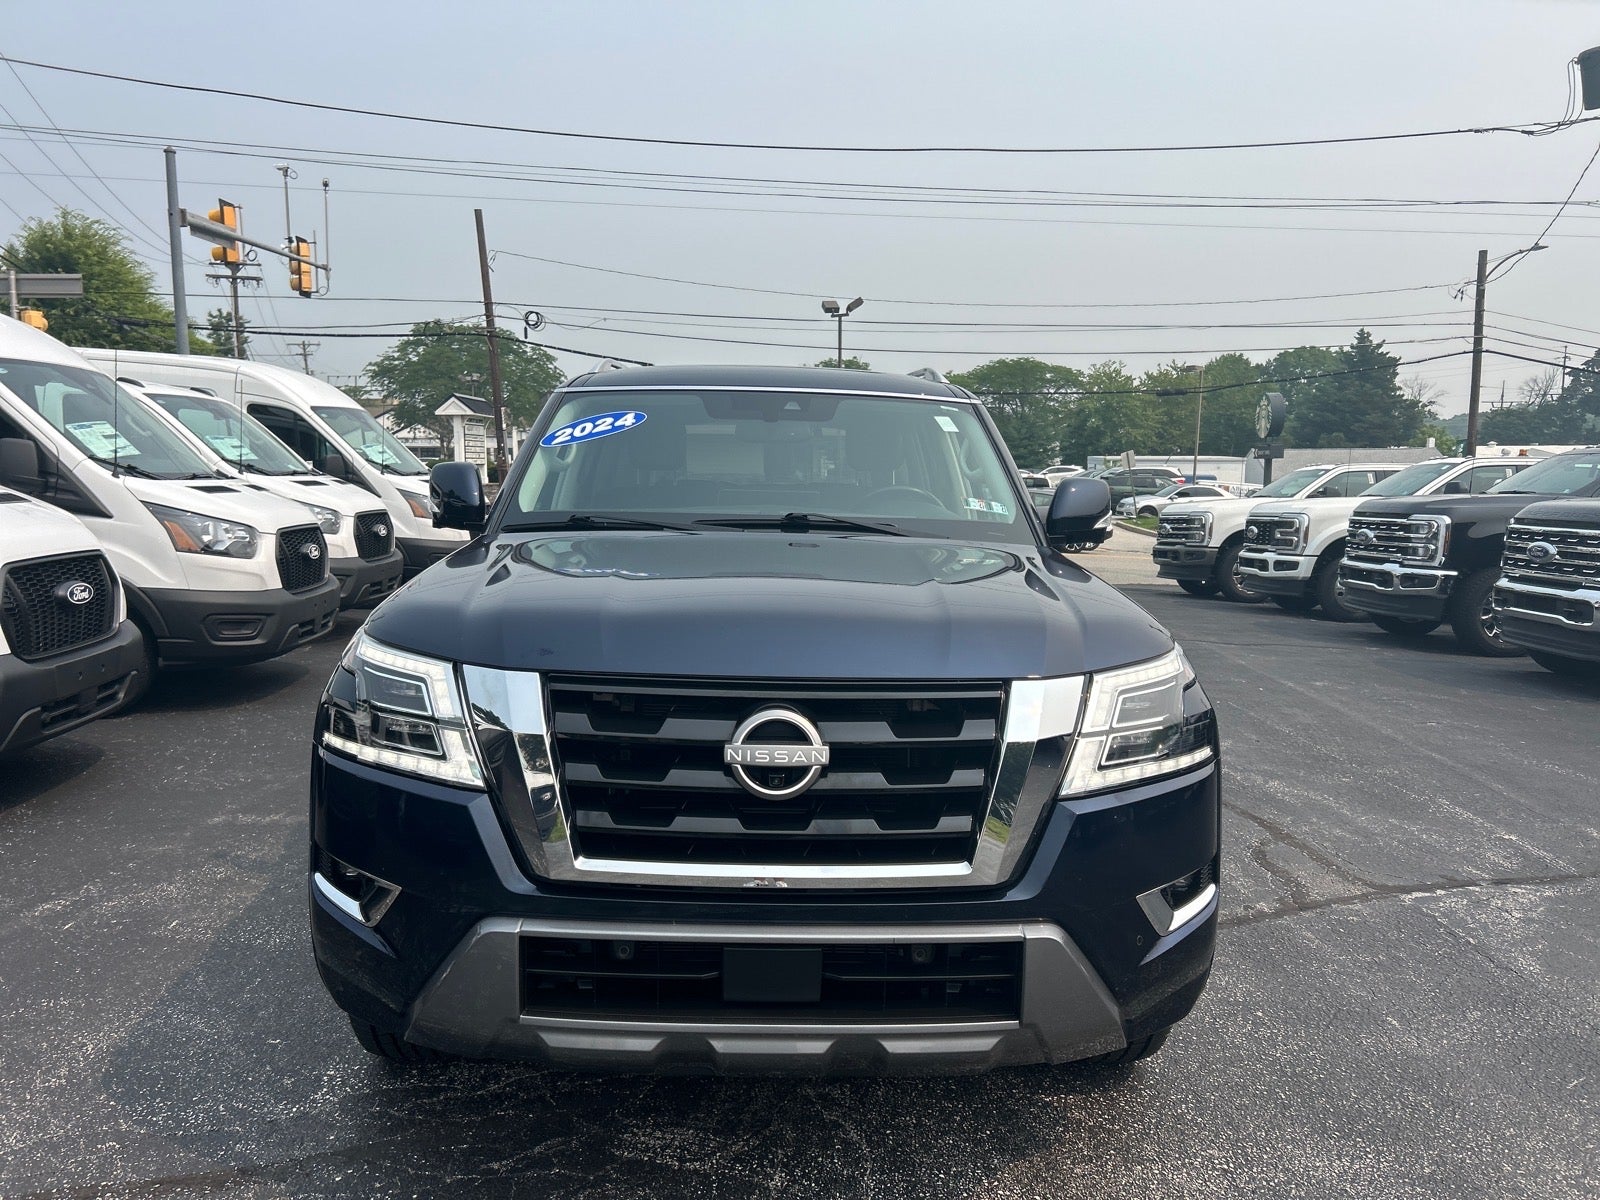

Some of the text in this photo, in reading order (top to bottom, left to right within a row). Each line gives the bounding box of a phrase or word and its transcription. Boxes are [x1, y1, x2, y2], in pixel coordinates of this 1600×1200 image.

[551, 412, 636, 445] 2024
[73, 586, 89, 601] Ford
[727, 748, 826, 763] NISSAN
